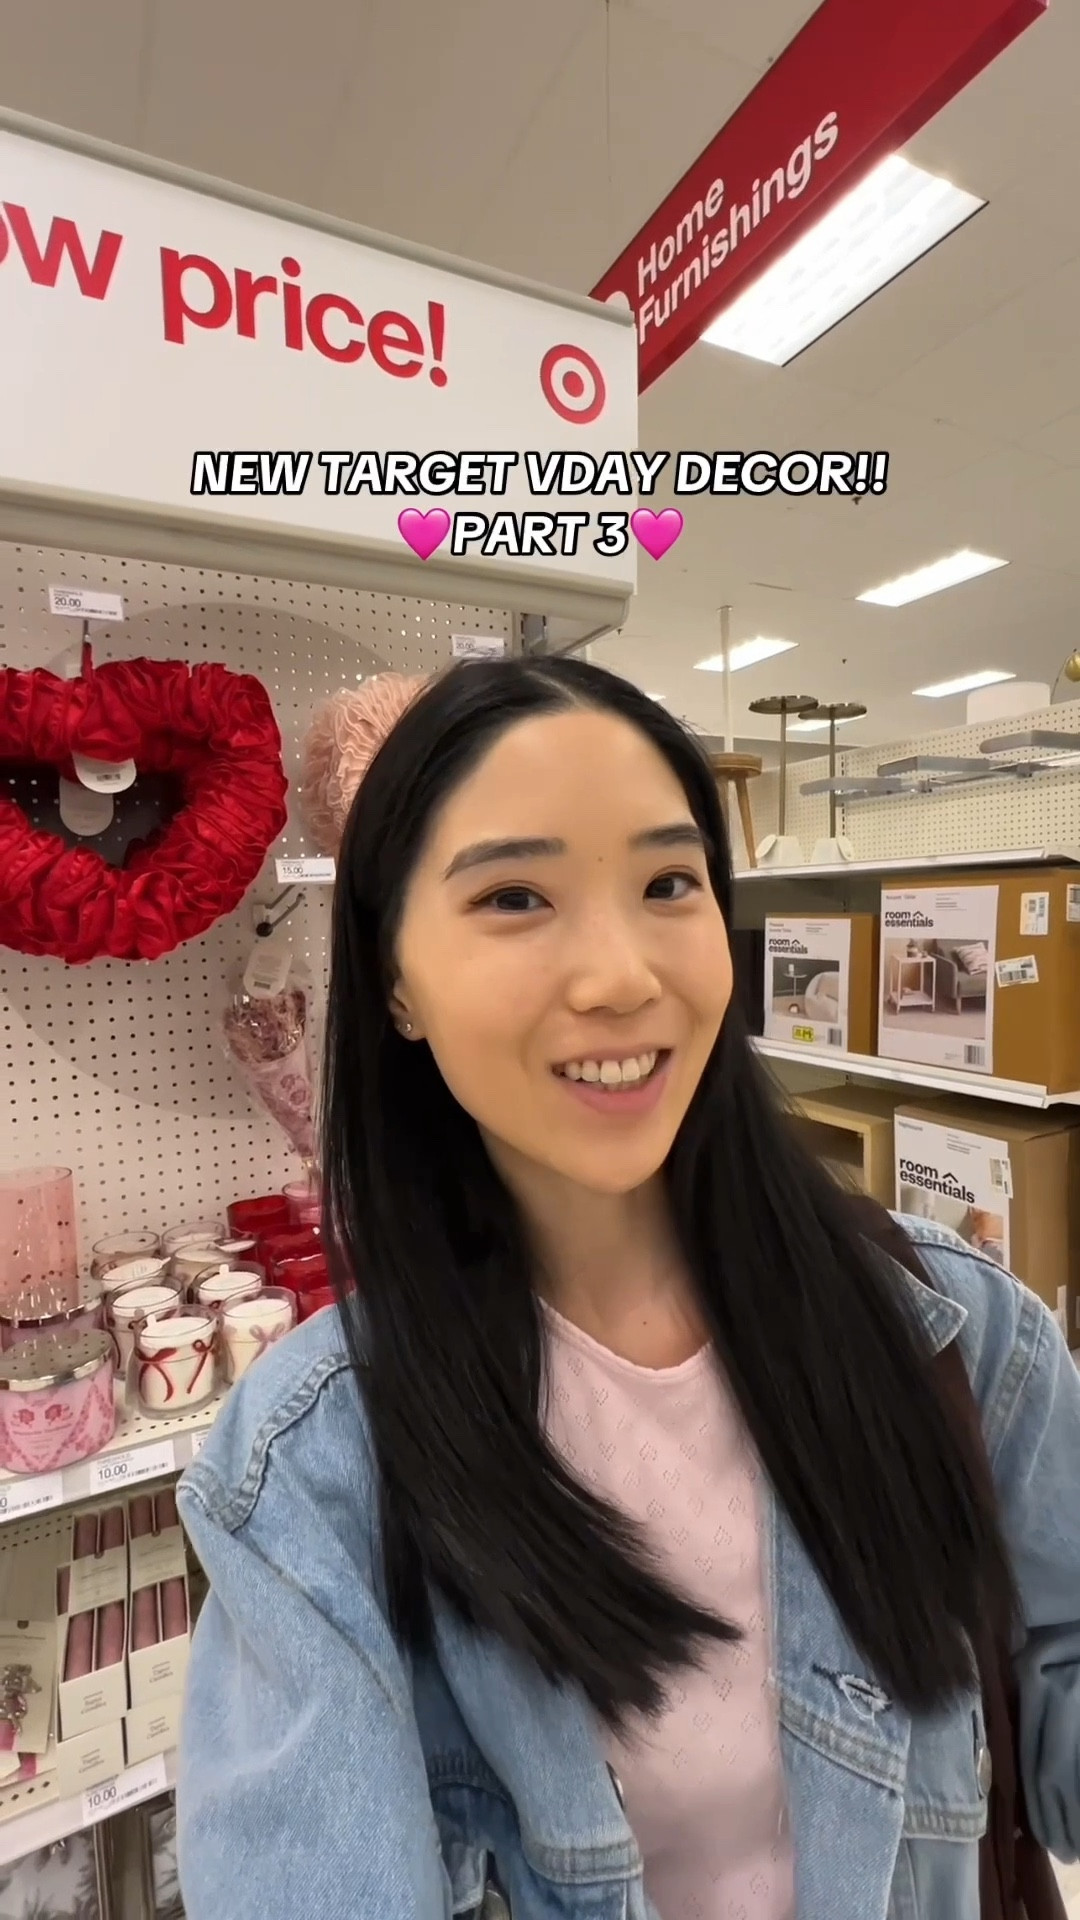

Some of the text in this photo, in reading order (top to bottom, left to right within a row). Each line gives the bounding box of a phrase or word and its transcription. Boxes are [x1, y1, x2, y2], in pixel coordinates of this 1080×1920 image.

[637, 177, 724, 298] Home
[638, 111, 839, 346] Furnishings
[0, 200, 448, 388] w price!
[54, 596, 82, 608] 20.00
[884, 911, 911, 920] room
[884, 916, 934, 928] essentials
[768, 938, 790, 947] room
[768, 944, 808, 955] essentials
[899, 1158, 938, 1180] room
[899, 1170, 975, 1204] essentials
[98, 1463, 128, 1481] 10.00
[87, 1786, 117, 1809] 10.00
